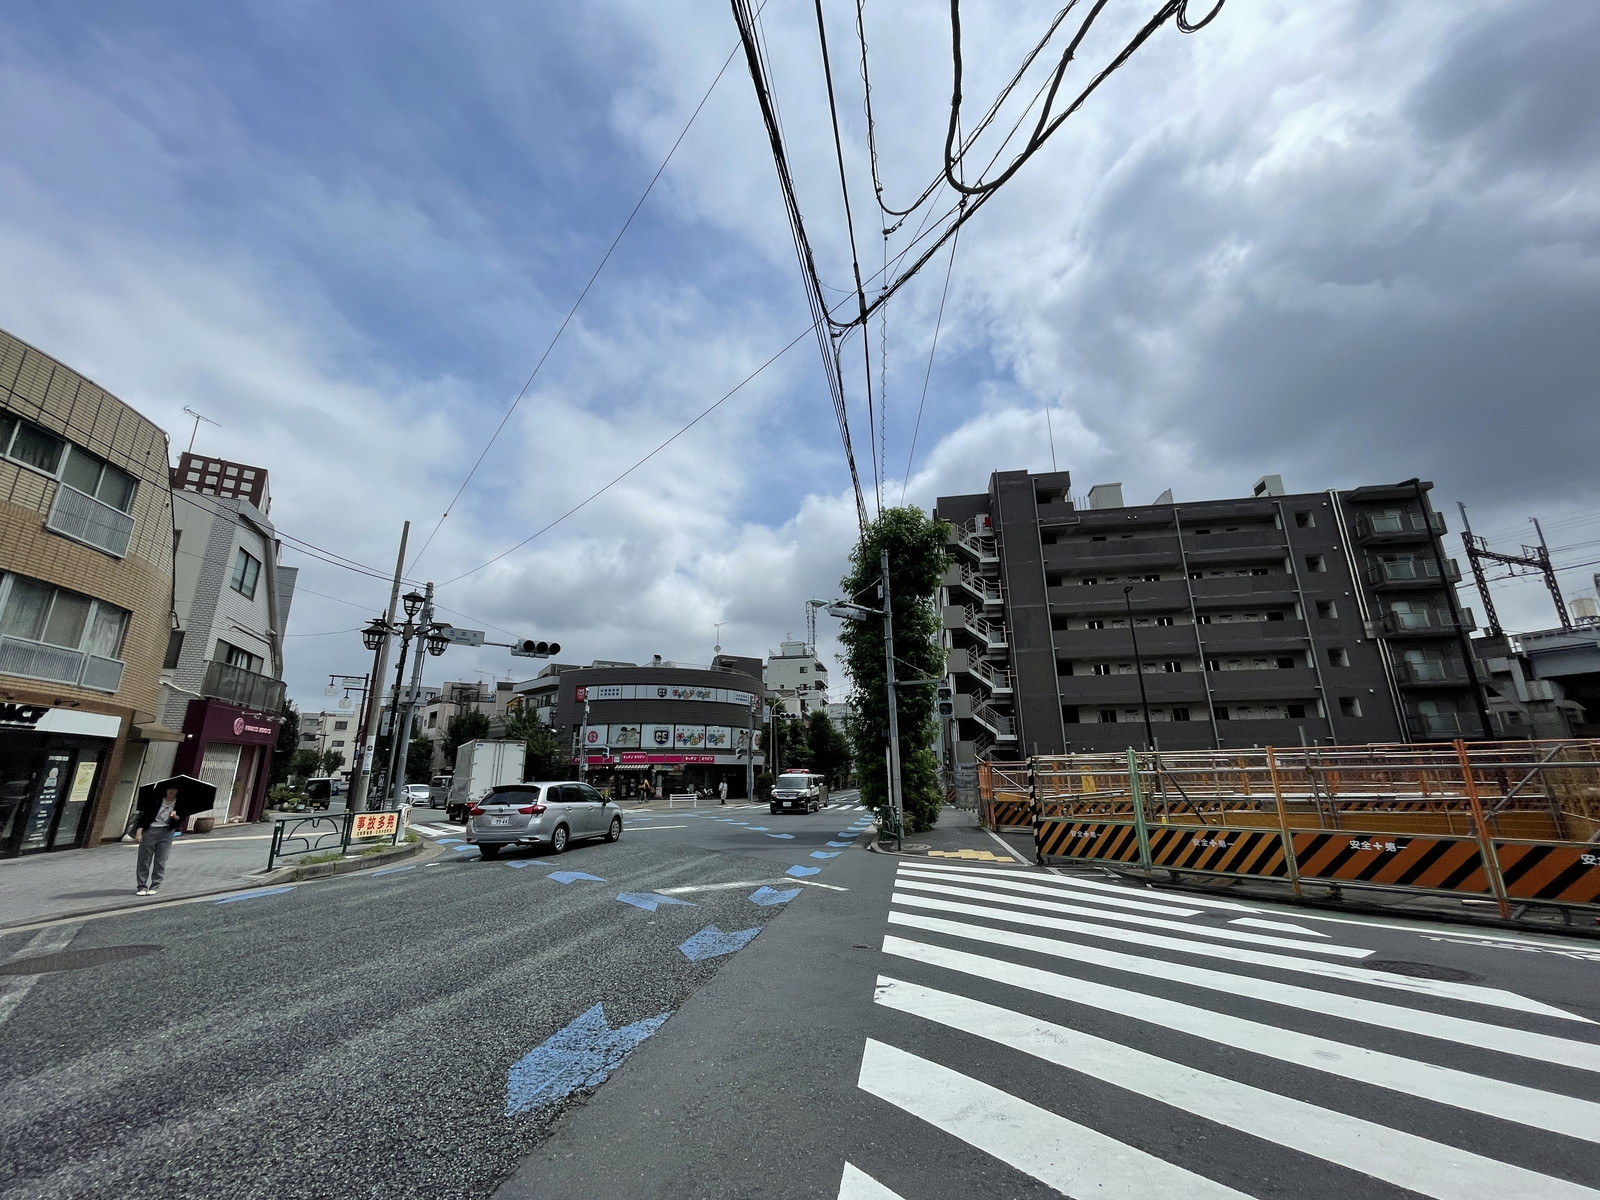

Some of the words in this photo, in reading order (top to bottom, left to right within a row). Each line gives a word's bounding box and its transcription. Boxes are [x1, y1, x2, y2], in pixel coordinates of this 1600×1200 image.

[655, 731, 668, 742] CE
[356, 814, 395, 831] 事故多発
[1580, 853, 1600, 866] 安
